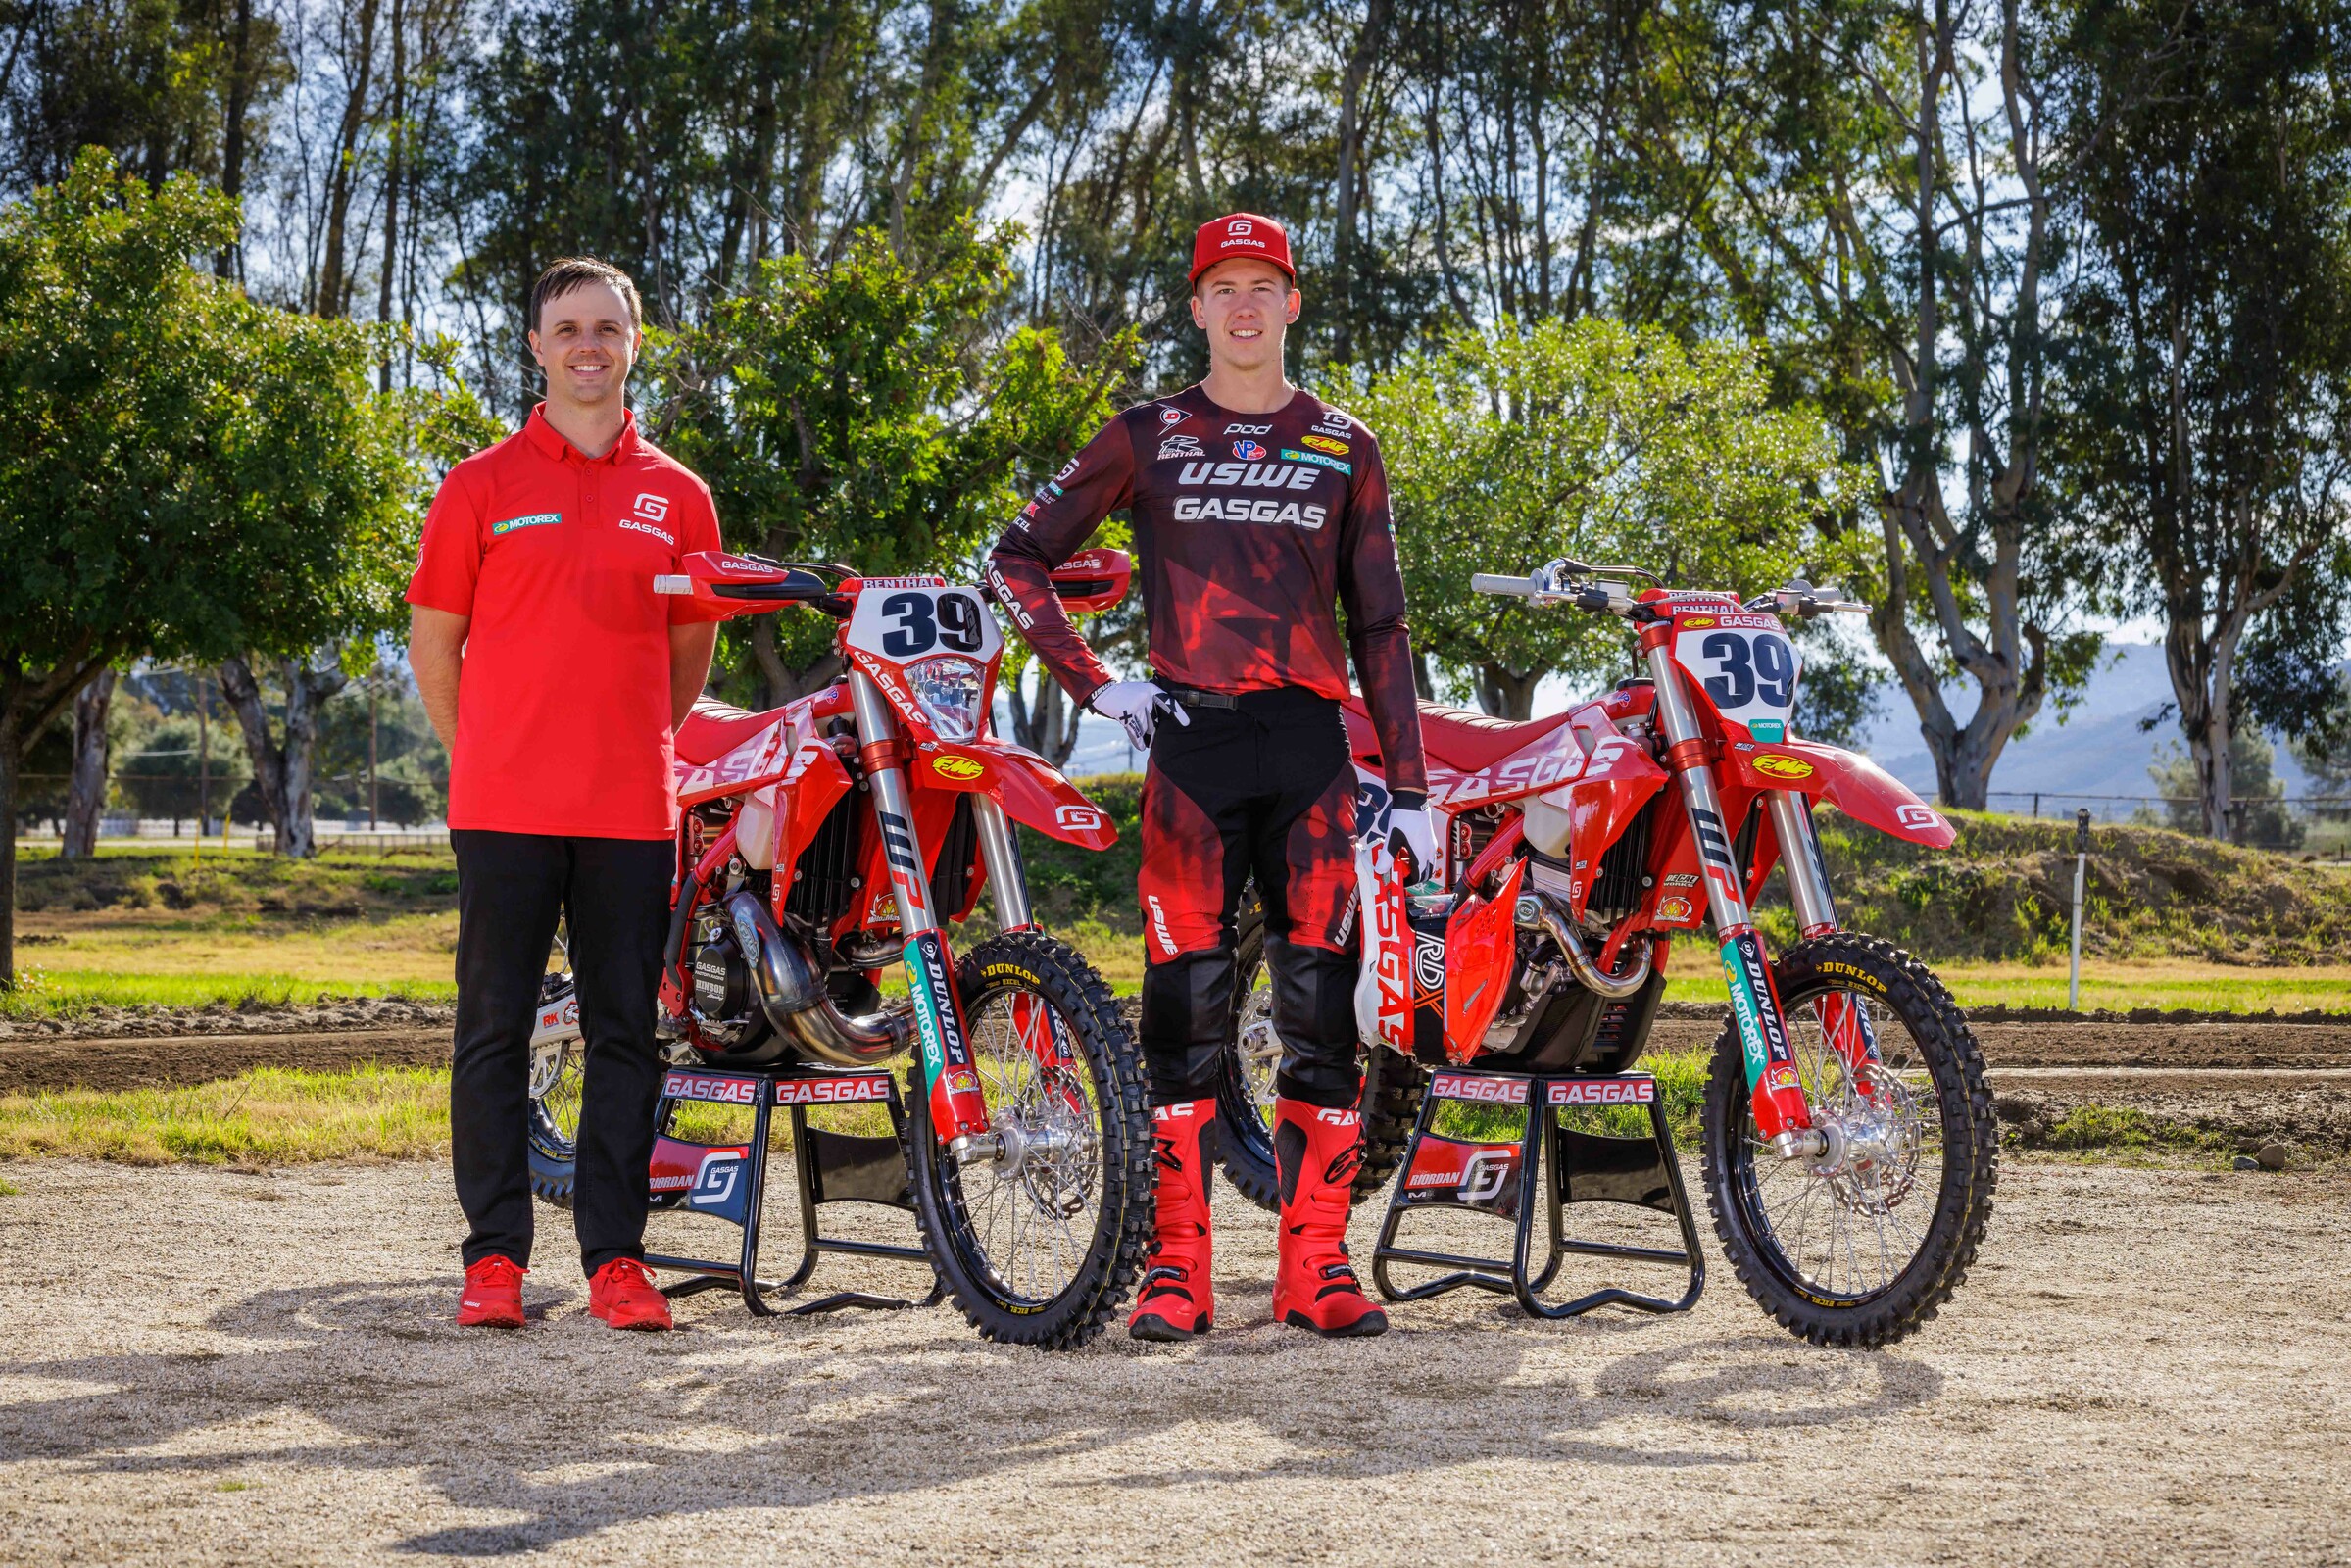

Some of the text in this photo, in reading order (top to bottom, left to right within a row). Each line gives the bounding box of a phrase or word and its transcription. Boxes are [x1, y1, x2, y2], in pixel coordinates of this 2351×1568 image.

[1220, 238, 1265, 249] GASGAS
[1223, 423, 1273, 435] pod
[1311, 425, 1352, 439] GASGAS
[1157, 451, 1206, 461] RENTHAL
[1301, 453, 1350, 474] MOTOREX
[1178, 462, 1320, 490] USWE
[509, 514, 559, 530] MOTOREX
[1174, 498, 1326, 529] GASGAS
[618, 519, 675, 546] GASGAS
[721, 561, 774, 574] GASGAS
[1054, 559, 1101, 570] ASGAS
[863, 578, 941, 588] RENTHAL
[987, 560, 1035, 631] ASGAS
[882, 592, 983, 658] 39
[1720, 616, 1781, 631] GASGAS
[1702, 632, 1795, 709] 39
[854, 650, 928, 723] GASGAS
[932, 758, 985, 775] FMF
[1752, 757, 1814, 774] FMF
[1666, 874, 1700, 883] DECAL
[1148, 894, 1179, 956] USWE
[696, 961, 726, 976] GASGAS
[986, 963, 1040, 985] DUNLOP
[1823, 962, 1888, 994] DUNLOP
[696, 979, 725, 995] HINSON
[543, 1012, 559, 1026] RK
[928, 962, 964, 1064] DUNLOP
[1747, 961, 1788, 1060] DUNLOP
[911, 984, 941, 1069] MOTOREX
[1730, 982, 1765, 1065] MOTOREX
[664, 1078, 756, 1103] GASGAS
[776, 1080, 890, 1103] GASGAS
[1431, 1079, 1528, 1103] GASGAS
[1548, 1084, 1653, 1103] GASGAS
[710, 1165, 739, 1174] GASGAS
[1409, 1172, 1460, 1186] RIORDAN
